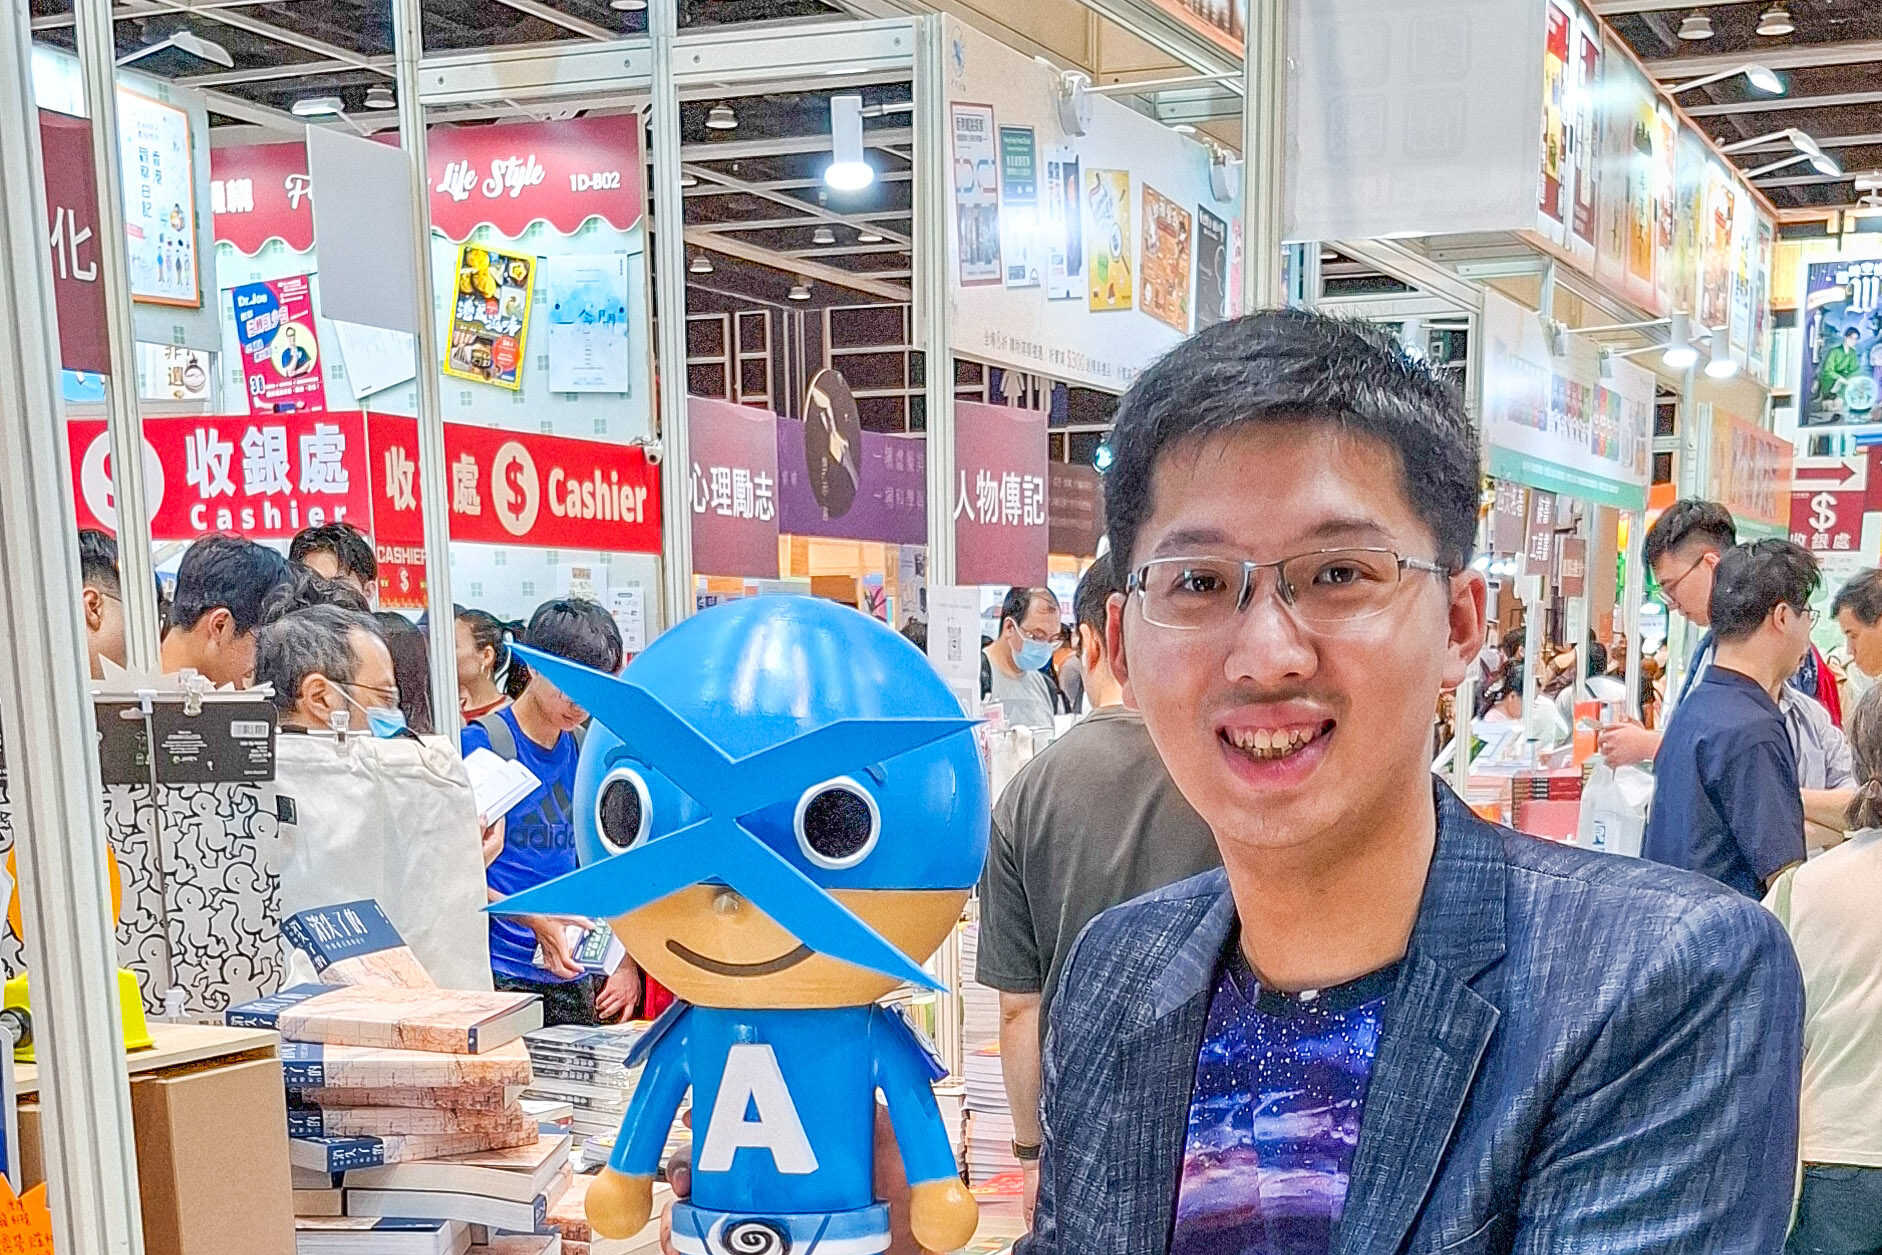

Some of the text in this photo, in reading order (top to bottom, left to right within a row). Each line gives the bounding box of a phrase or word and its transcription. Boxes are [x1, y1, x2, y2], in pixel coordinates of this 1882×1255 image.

[436, 154, 546, 202] Life Style
[50, 206, 98, 282] 化
[185, 422, 350, 499] 收銀處
[189, 500, 348, 531] Cashier
[548, 468, 647, 524] Cashier
[688, 461, 776, 522] 心理勵志
[952, 468, 1045, 527] 人物傳記
[698, 1043, 820, 1175] A
